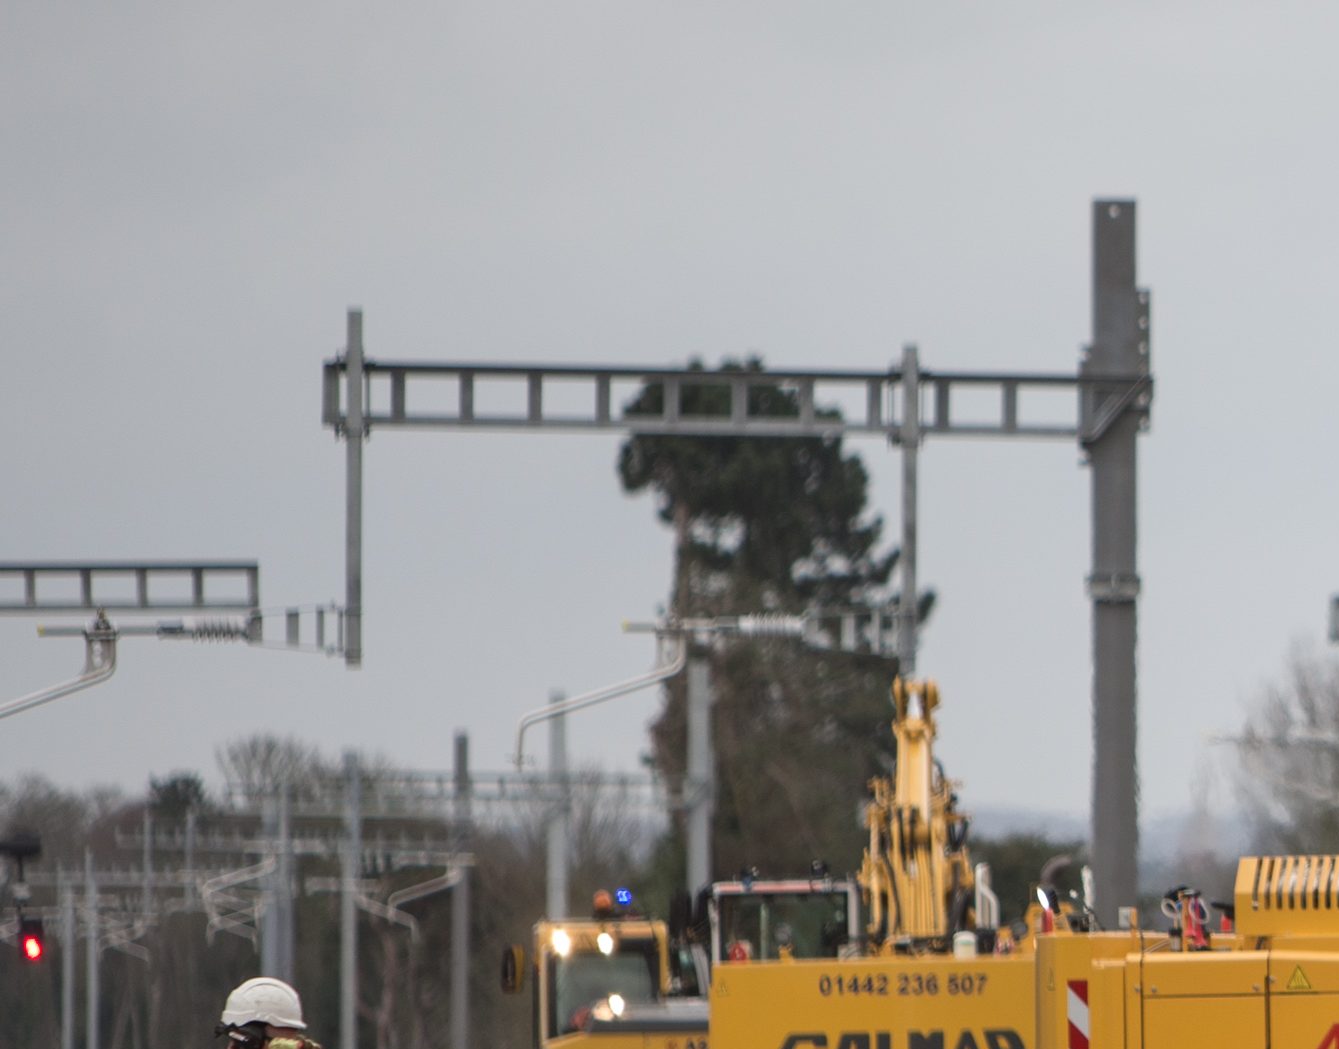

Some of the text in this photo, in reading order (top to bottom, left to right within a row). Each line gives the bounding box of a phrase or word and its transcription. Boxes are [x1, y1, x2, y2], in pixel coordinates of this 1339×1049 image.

[818, 972, 988, 996] 01442 236 507
